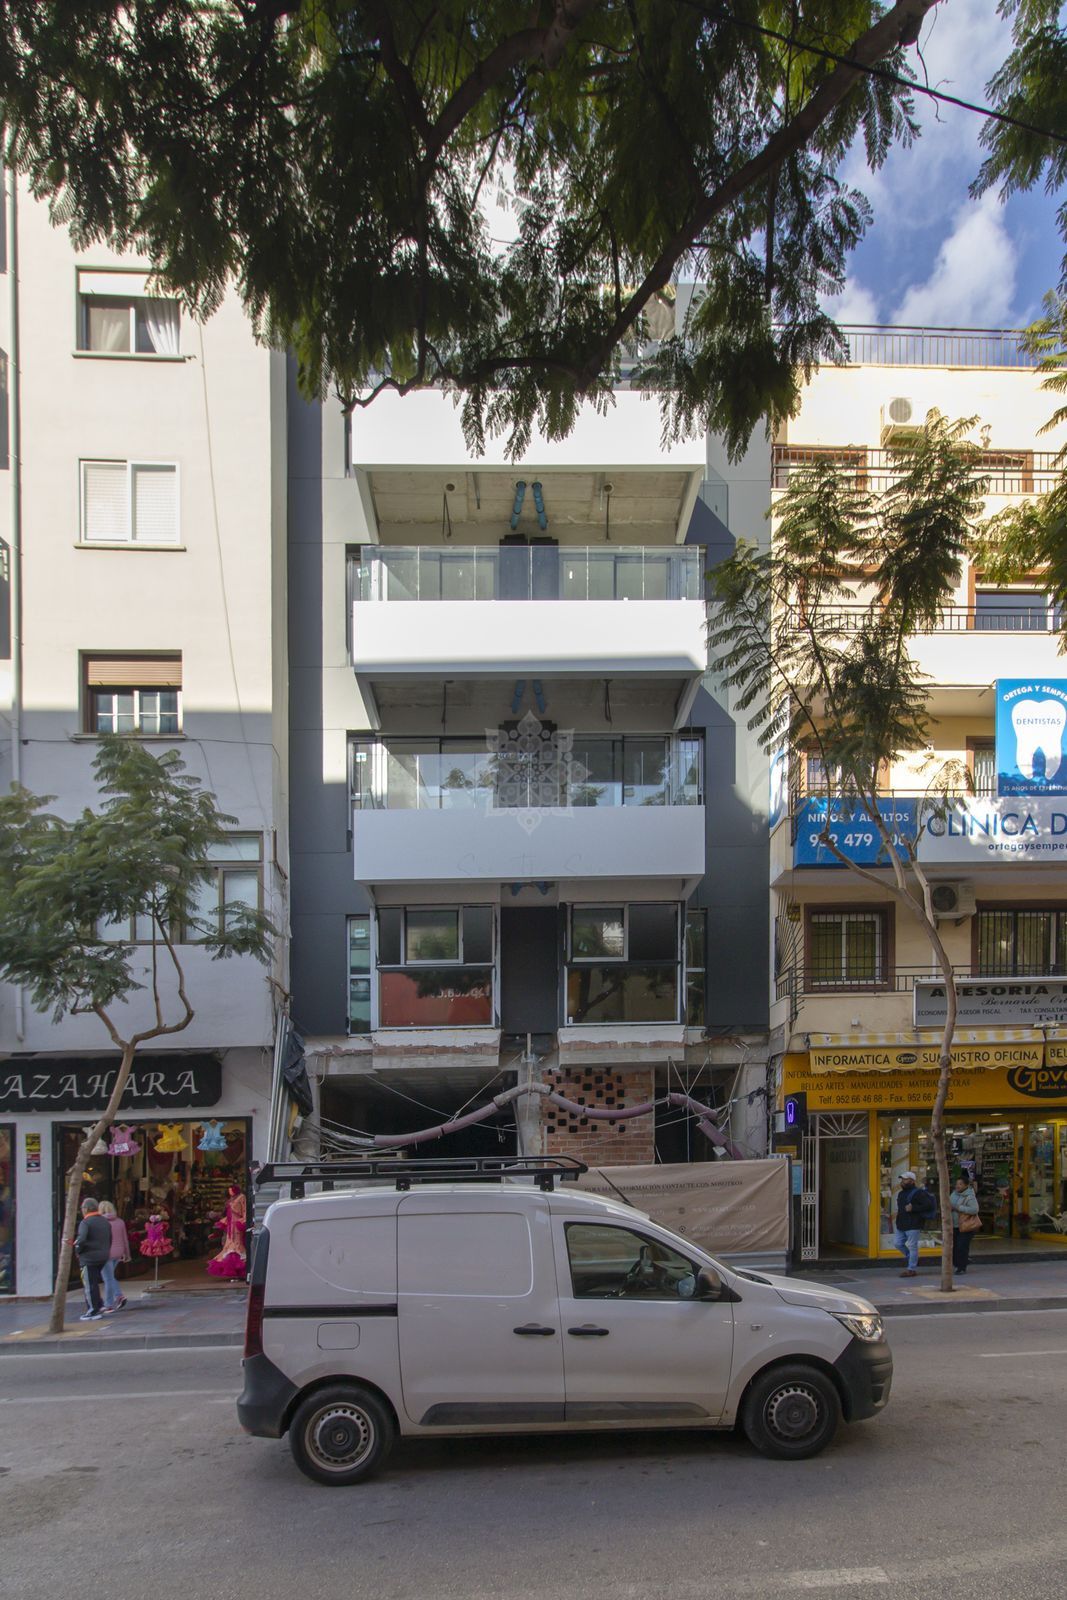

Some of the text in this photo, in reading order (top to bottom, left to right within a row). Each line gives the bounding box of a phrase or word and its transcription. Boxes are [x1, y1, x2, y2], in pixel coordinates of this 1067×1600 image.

[1003, 685, 1033, 702] ORTEGA
[809, 833, 838, 847] 92
[843, 833, 873, 847] 479
[922, 1051, 991, 1063] SUNISTRO
[994, 1050, 1039, 1062] OFICINA
[0, 1070, 200, 1100] AZAHARA
[835, 1095, 850, 1104] 952
